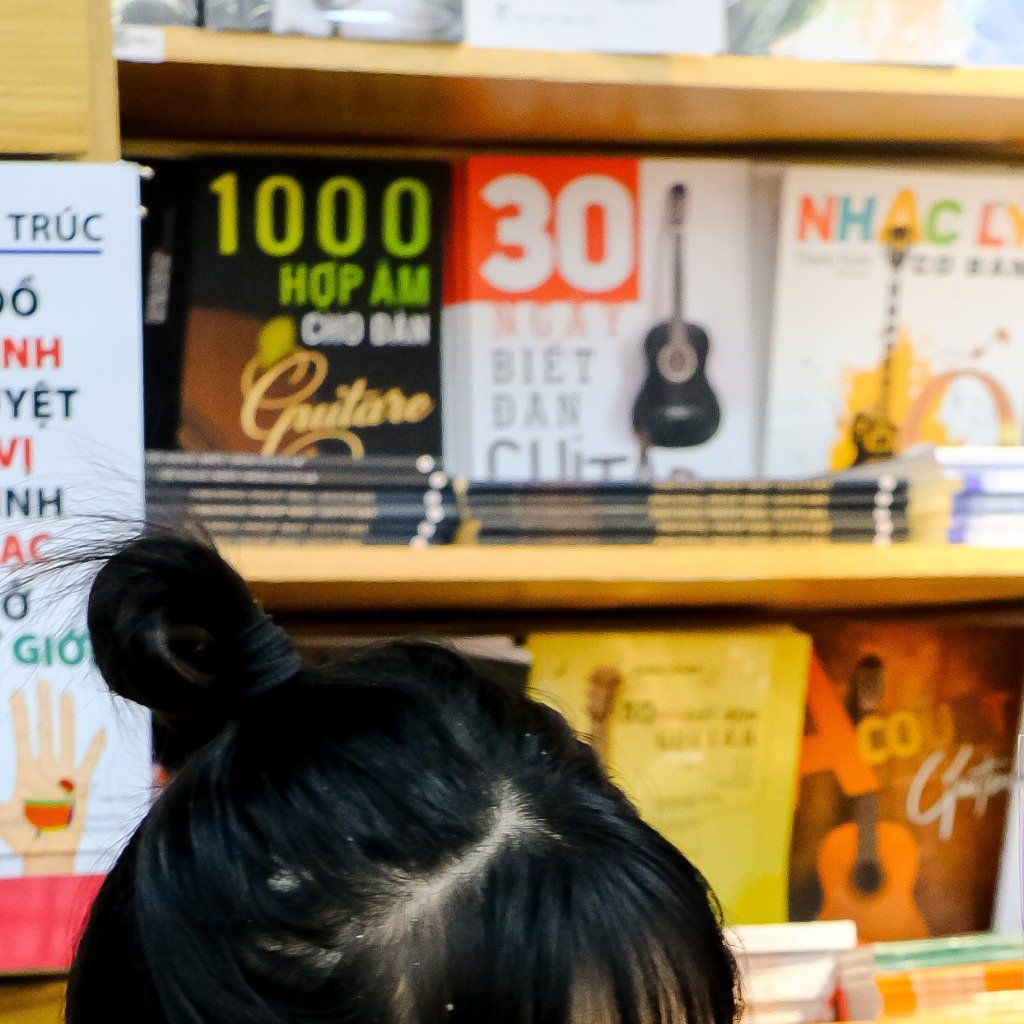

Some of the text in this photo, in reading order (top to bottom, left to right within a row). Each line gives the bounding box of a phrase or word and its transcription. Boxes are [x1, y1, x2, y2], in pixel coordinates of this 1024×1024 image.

[8, 206, 103, 241] TRÚC
[209, 172, 431, 257] 1000
[479, 173, 635, 293] 30
